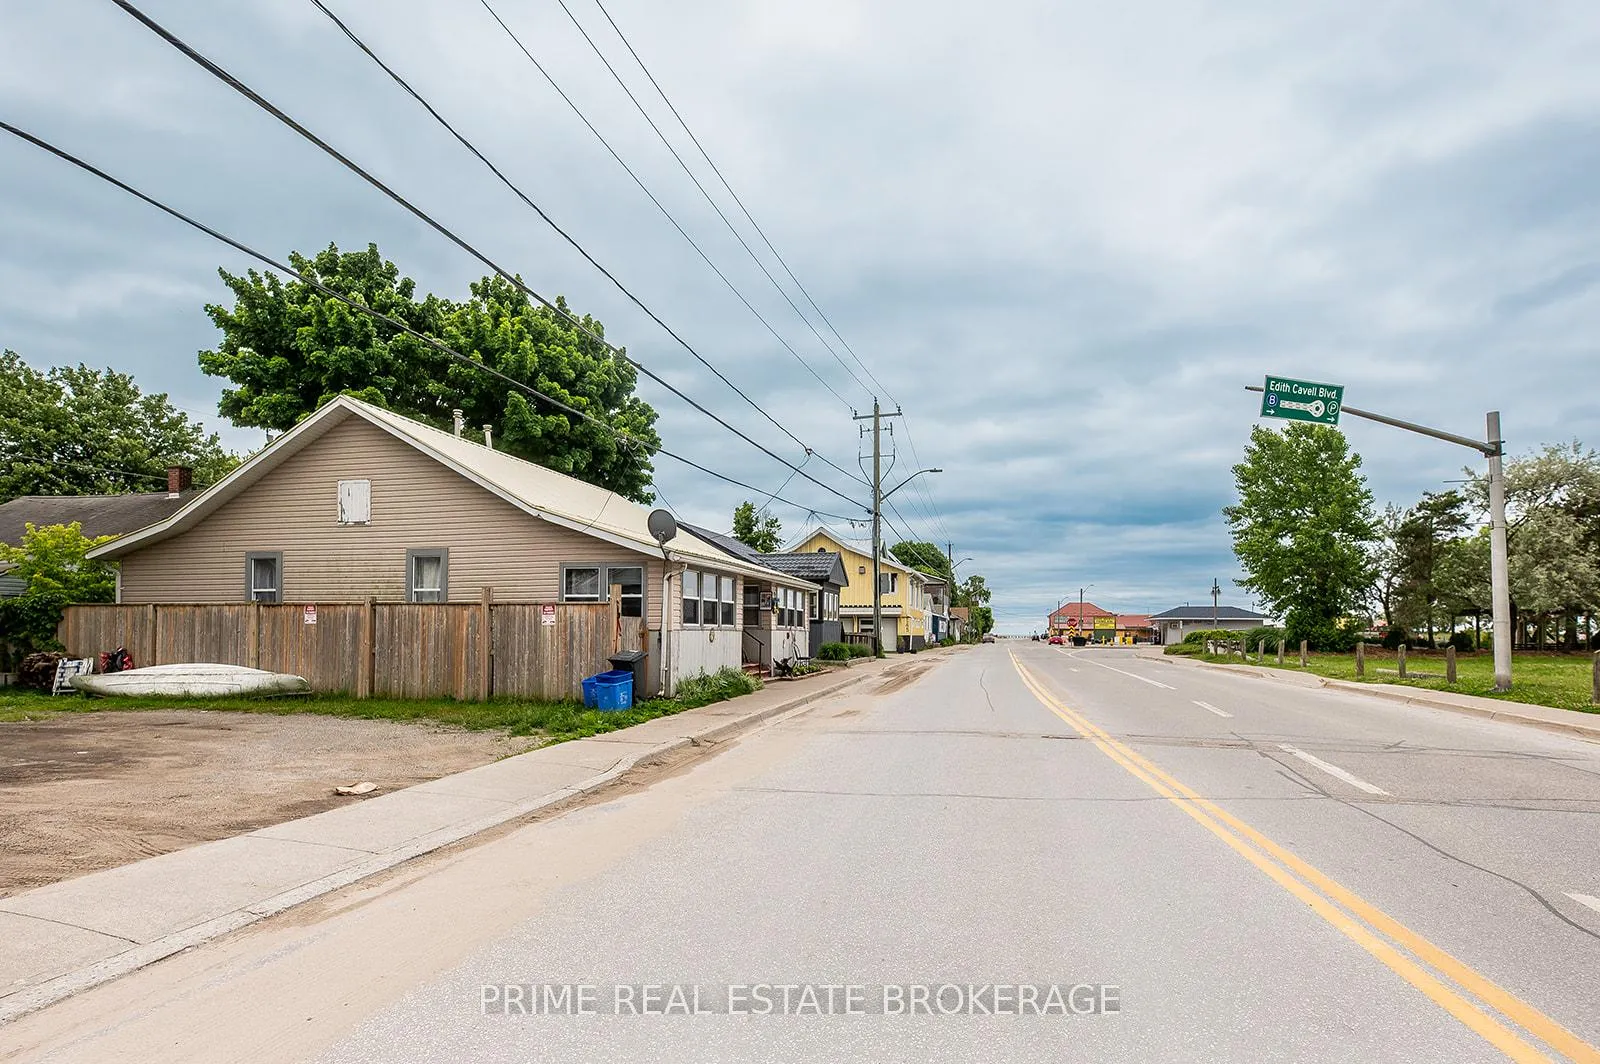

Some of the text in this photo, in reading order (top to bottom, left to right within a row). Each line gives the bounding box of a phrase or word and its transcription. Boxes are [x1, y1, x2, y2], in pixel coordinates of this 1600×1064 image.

[1269, 380, 1338, 399] Edith Cavell Blvd.
[1330, 403, 1337, 413] P
